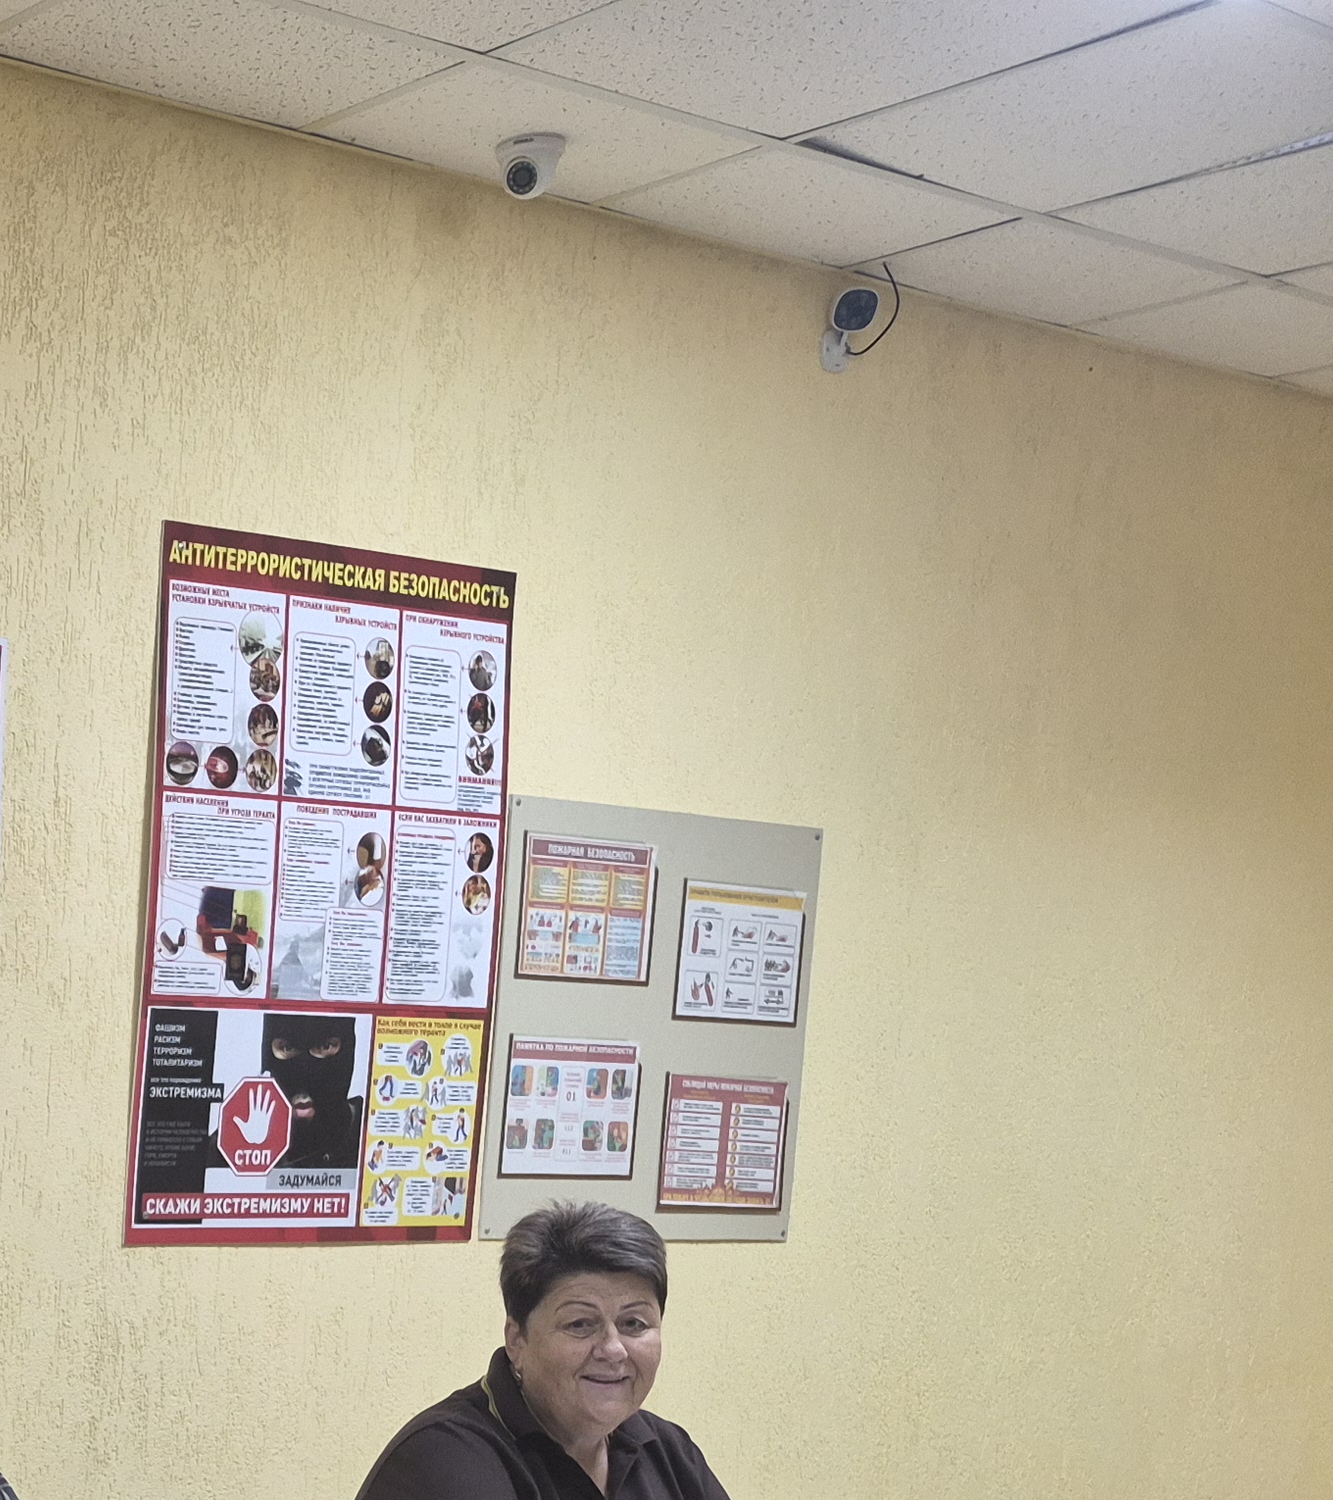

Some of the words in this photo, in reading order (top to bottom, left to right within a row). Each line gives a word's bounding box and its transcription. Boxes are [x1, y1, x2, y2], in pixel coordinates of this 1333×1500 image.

[169, 540, 385, 590] АНТИТЕРРОРИСТИЧЕСКАЯ
[389, 574, 510, 609] БЕЗОПАСНОСТЬ
[154, 1035, 181, 1044] РАСИЗМ
[153, 1047, 192, 1055] ТЕРРОРИЗМ
[149, 1087, 222, 1099] ЭКСТРЕМИЗМА
[235, 1149, 271, 1165] СТОП
[279, 1173, 341, 1188] ЗАДУМАЙСЯ
[146, 1198, 201, 1214] СКАЖИ
[203, 1198, 311, 1214] ЭКСТРЕМИЗМУ
[313, 1197, 345, 1213] НЕТ!
